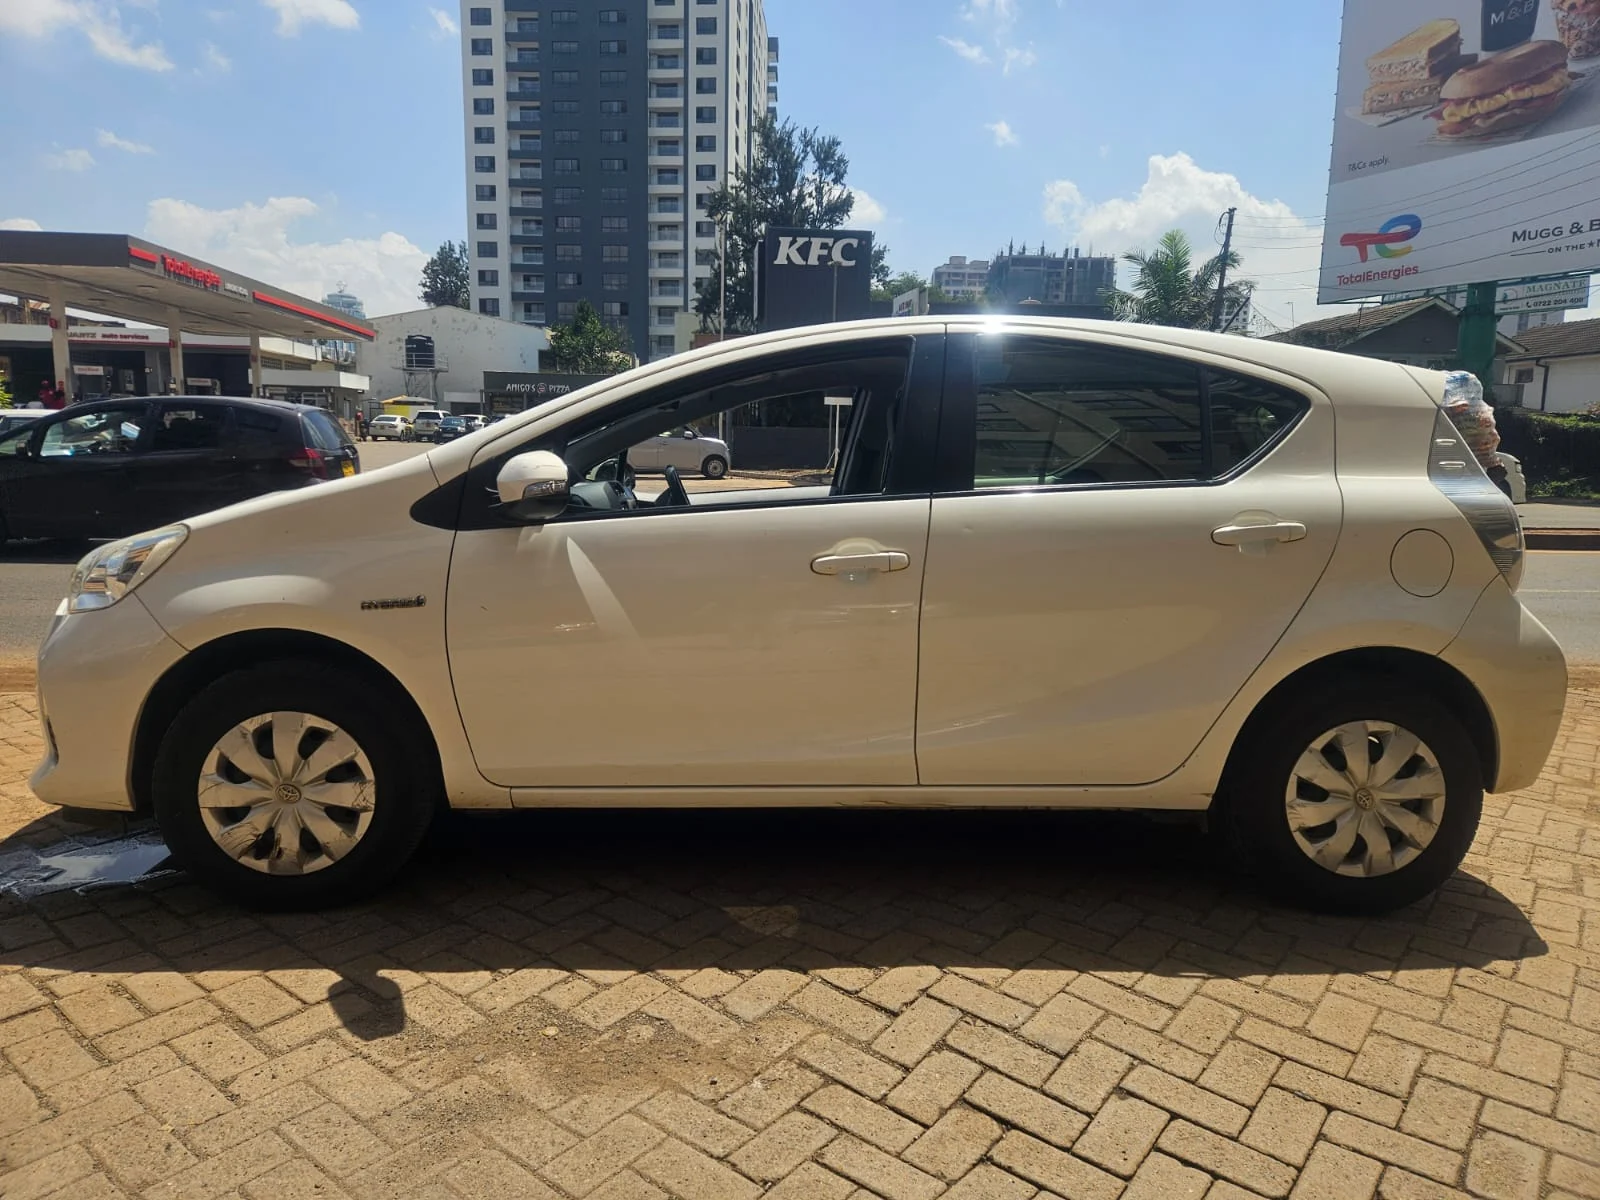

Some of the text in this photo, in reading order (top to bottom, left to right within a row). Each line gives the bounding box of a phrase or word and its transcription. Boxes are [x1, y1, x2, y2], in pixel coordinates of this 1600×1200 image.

[1511, 226, 1563, 243] MUGG
[1569, 221, 1584, 235] &
[773, 236, 858, 266] KFC
[1547, 243, 1586, 254] ON THE
[161, 254, 221, 287] TotalEnergies
[1337, 265, 1419, 286] TotalEnergies
[1526, 279, 1586, 294] MAGNATE
[506, 383, 571, 393] AMIGO'S PIZZA
